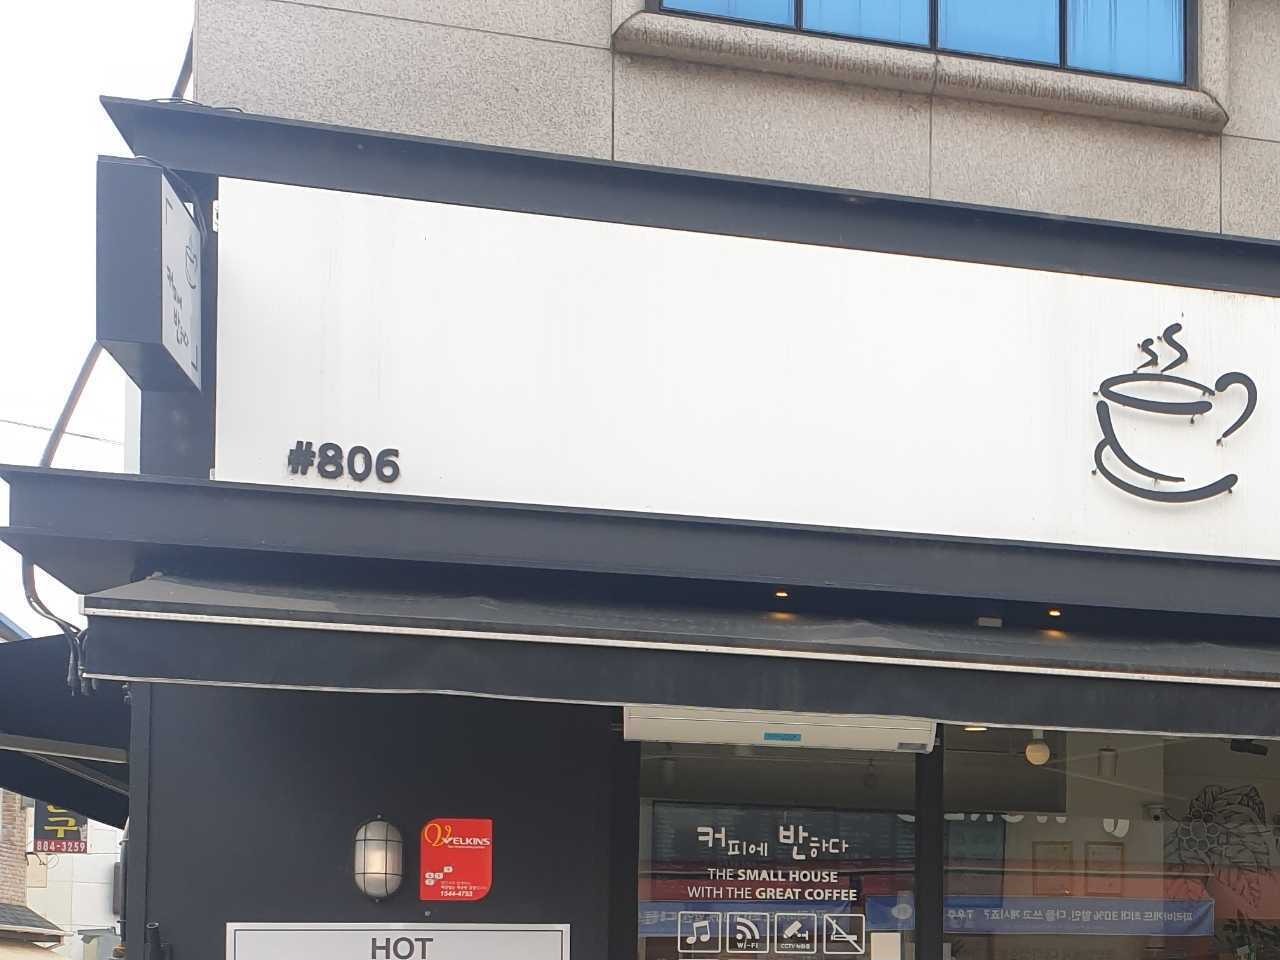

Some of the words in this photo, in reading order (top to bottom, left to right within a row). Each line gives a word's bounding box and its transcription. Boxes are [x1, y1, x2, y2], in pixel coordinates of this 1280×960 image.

[287, 440, 401, 484] #806
[697, 826, 769, 857] 커피에
[779, 824, 849, 860] 반하다
[707, 868, 734, 881] THE
[737, 869, 787, 882] SMALL
[789, 870, 838, 883] HOUSE
[687, 886, 723, 899] WITH
[726, 887, 753, 900] THE
[755, 888, 801, 900] GREAT
[804, 888, 857, 901] COFFEE
[371, 937, 434, 960] HOT
